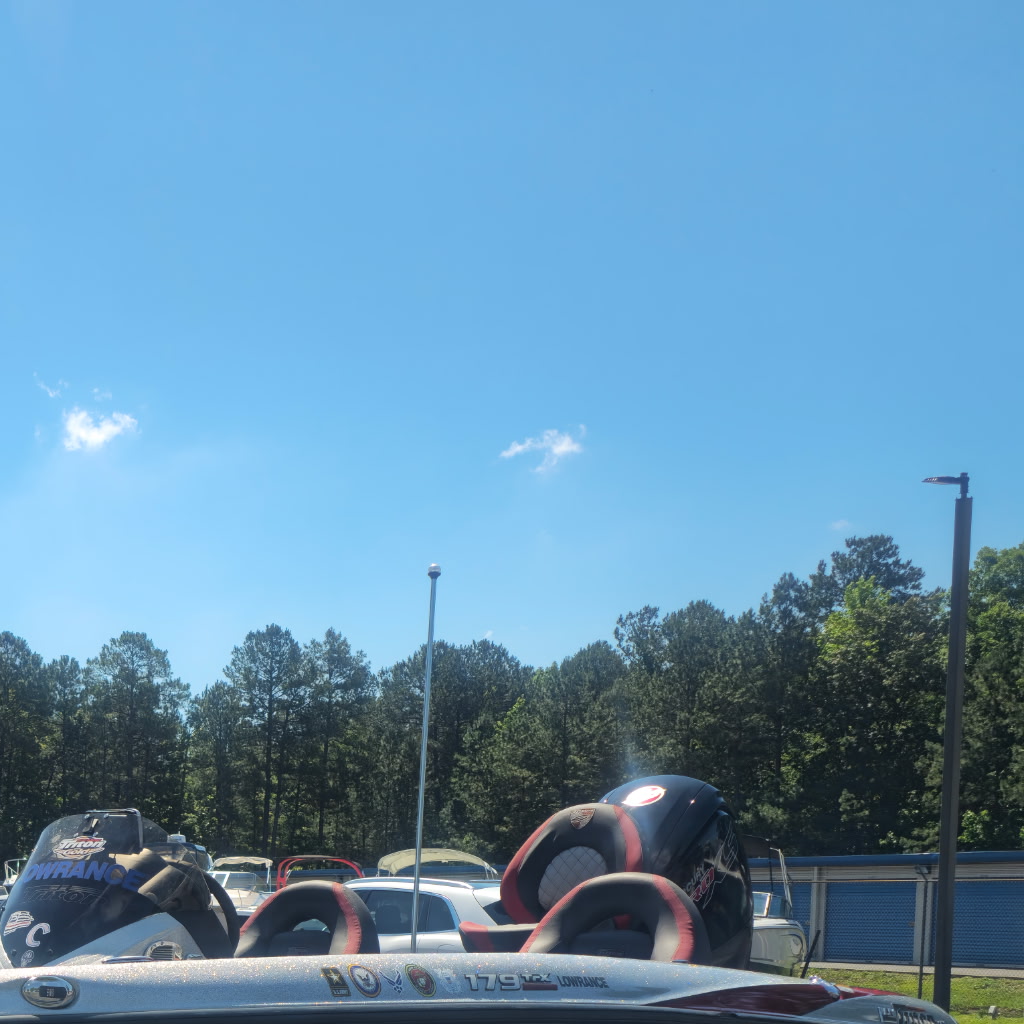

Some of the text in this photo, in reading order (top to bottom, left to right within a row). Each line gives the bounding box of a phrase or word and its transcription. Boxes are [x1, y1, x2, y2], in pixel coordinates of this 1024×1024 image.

[59, 838, 107, 850] Triton
[23, 860, 145, 893] OWRANCE
[465, 974, 522, 991] 179
[556, 975, 610, 988] LOWRANCE
